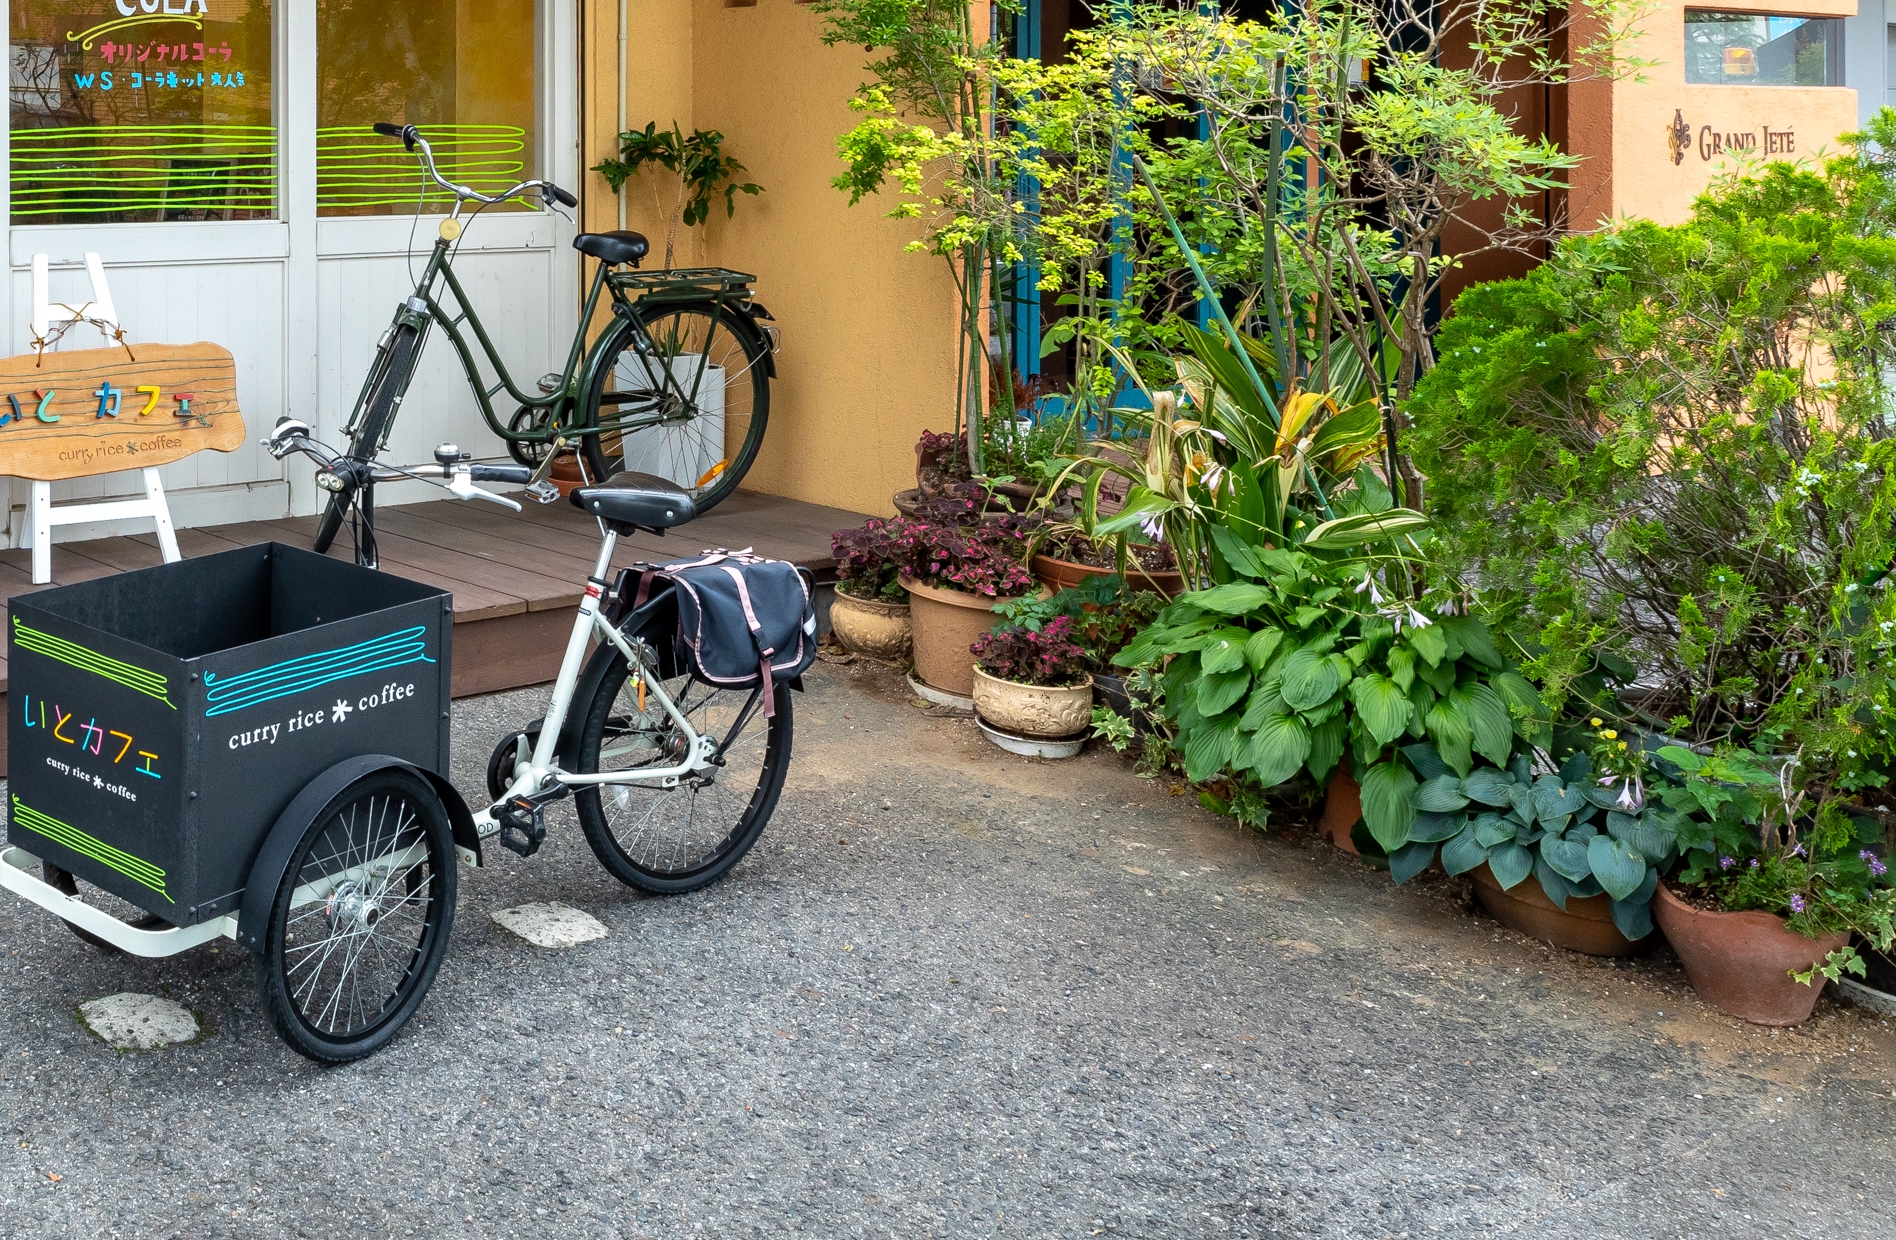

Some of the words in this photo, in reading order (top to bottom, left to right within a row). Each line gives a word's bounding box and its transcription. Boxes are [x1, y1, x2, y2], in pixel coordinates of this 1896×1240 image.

[100, 40, 233, 64] オリジナルコーラ
[59, 450, 94, 465] curry
[95, 440, 125, 458] rice
[139, 434, 183, 452] coffee
[24, 694, 162, 780] いとカフェ
[228, 720, 281, 751] curry
[288, 705, 325, 733] rice
[357, 680, 416, 712] coffee
[46, 755, 71, 776] curry
[72, 766, 91, 783] rice
[106, 780, 137, 802] coffee
